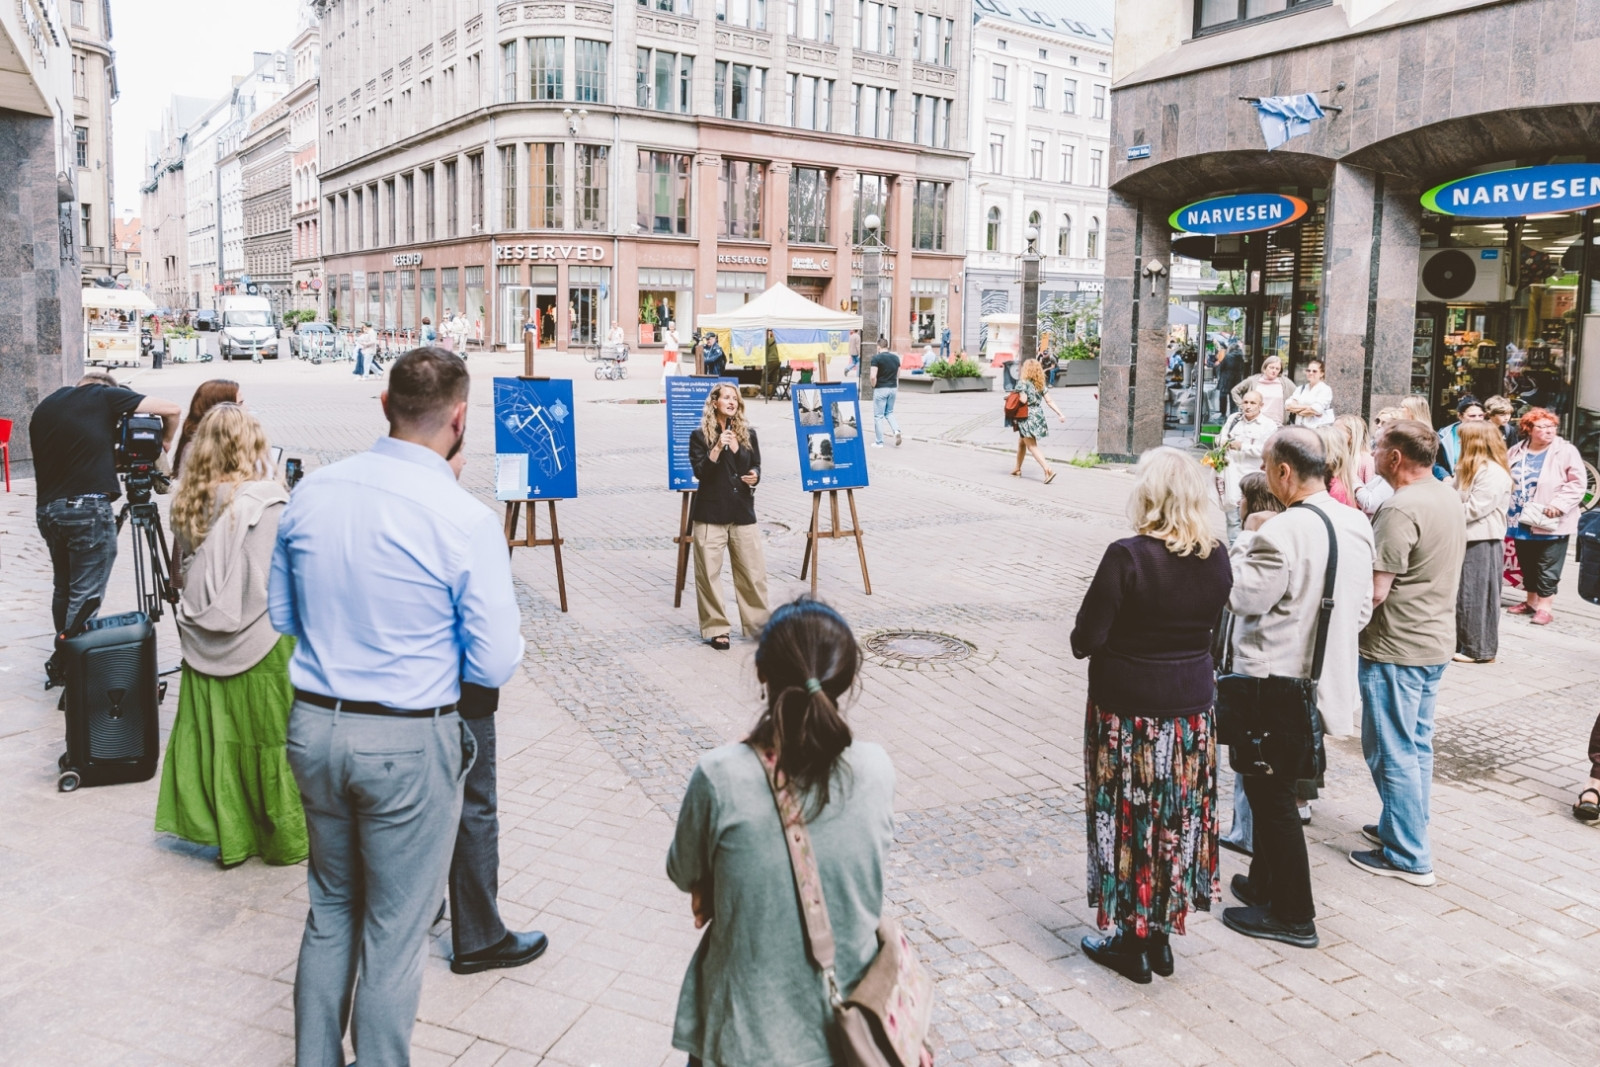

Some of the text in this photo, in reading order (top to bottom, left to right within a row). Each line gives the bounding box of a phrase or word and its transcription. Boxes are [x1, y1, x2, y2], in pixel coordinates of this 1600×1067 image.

[1187, 203, 1282, 225] NARVESEN
[393, 252, 423, 267] RESERVED
[496, 244, 605, 262] RESERVED
[717, 254, 769, 266] RESERVED
